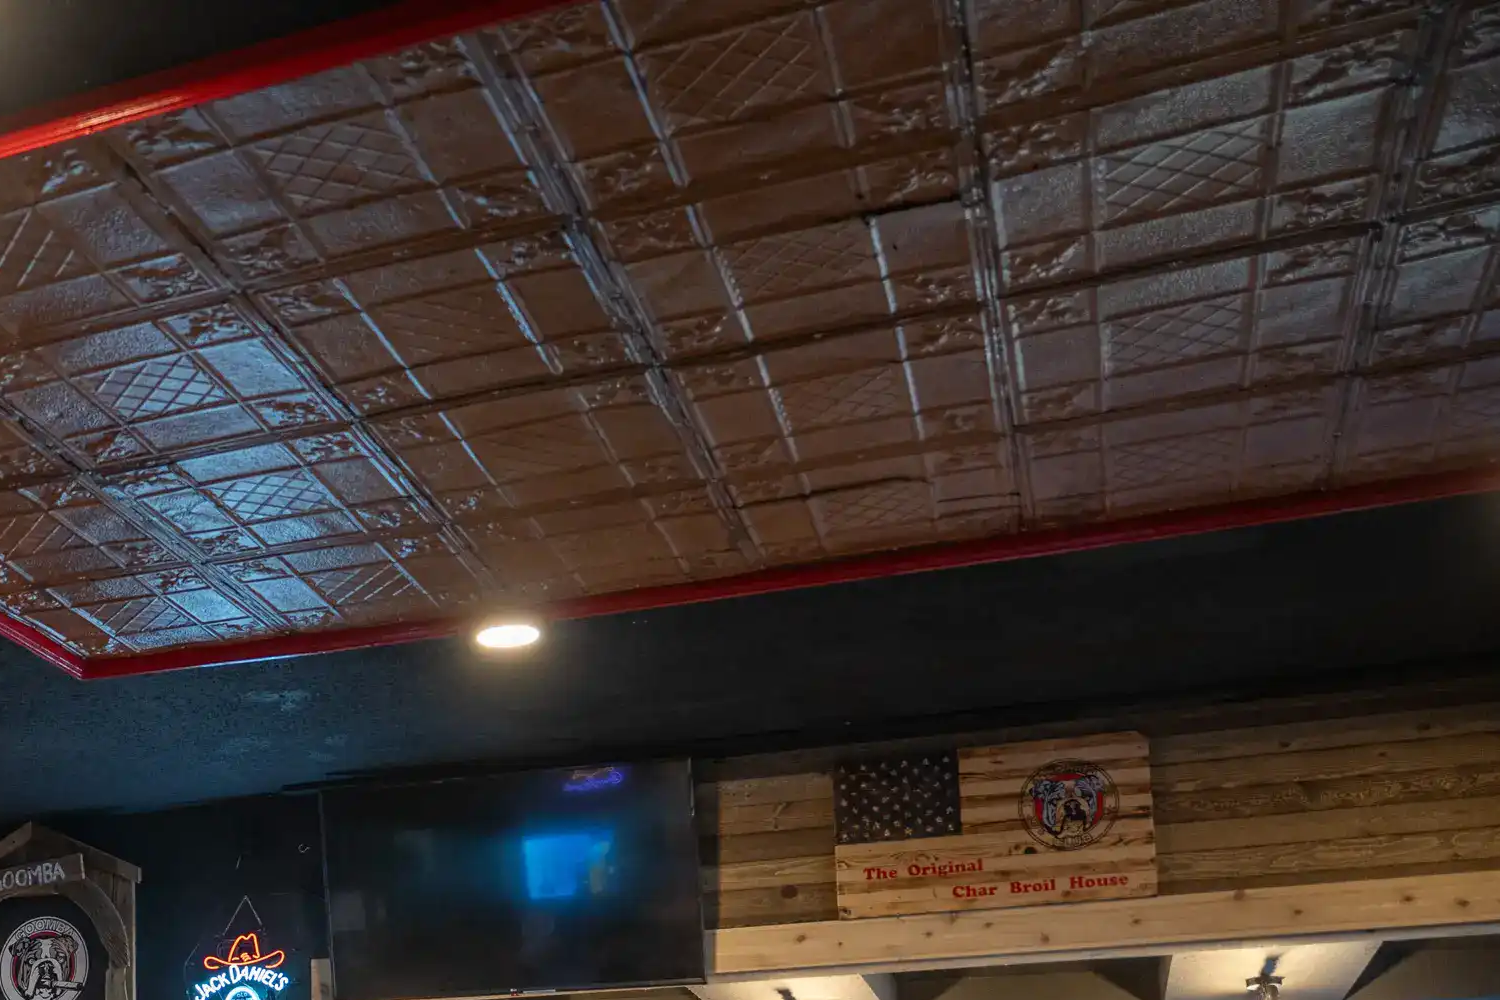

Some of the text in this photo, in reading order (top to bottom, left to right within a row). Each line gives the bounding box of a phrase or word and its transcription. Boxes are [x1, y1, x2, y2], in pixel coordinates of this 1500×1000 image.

[863, 858, 984, 881] The Original
[952, 874, 1129, 898] Char Broil House
[14, 918, 75, 942] GOOMBA
[228, 963, 290, 991] DANIEL'S
